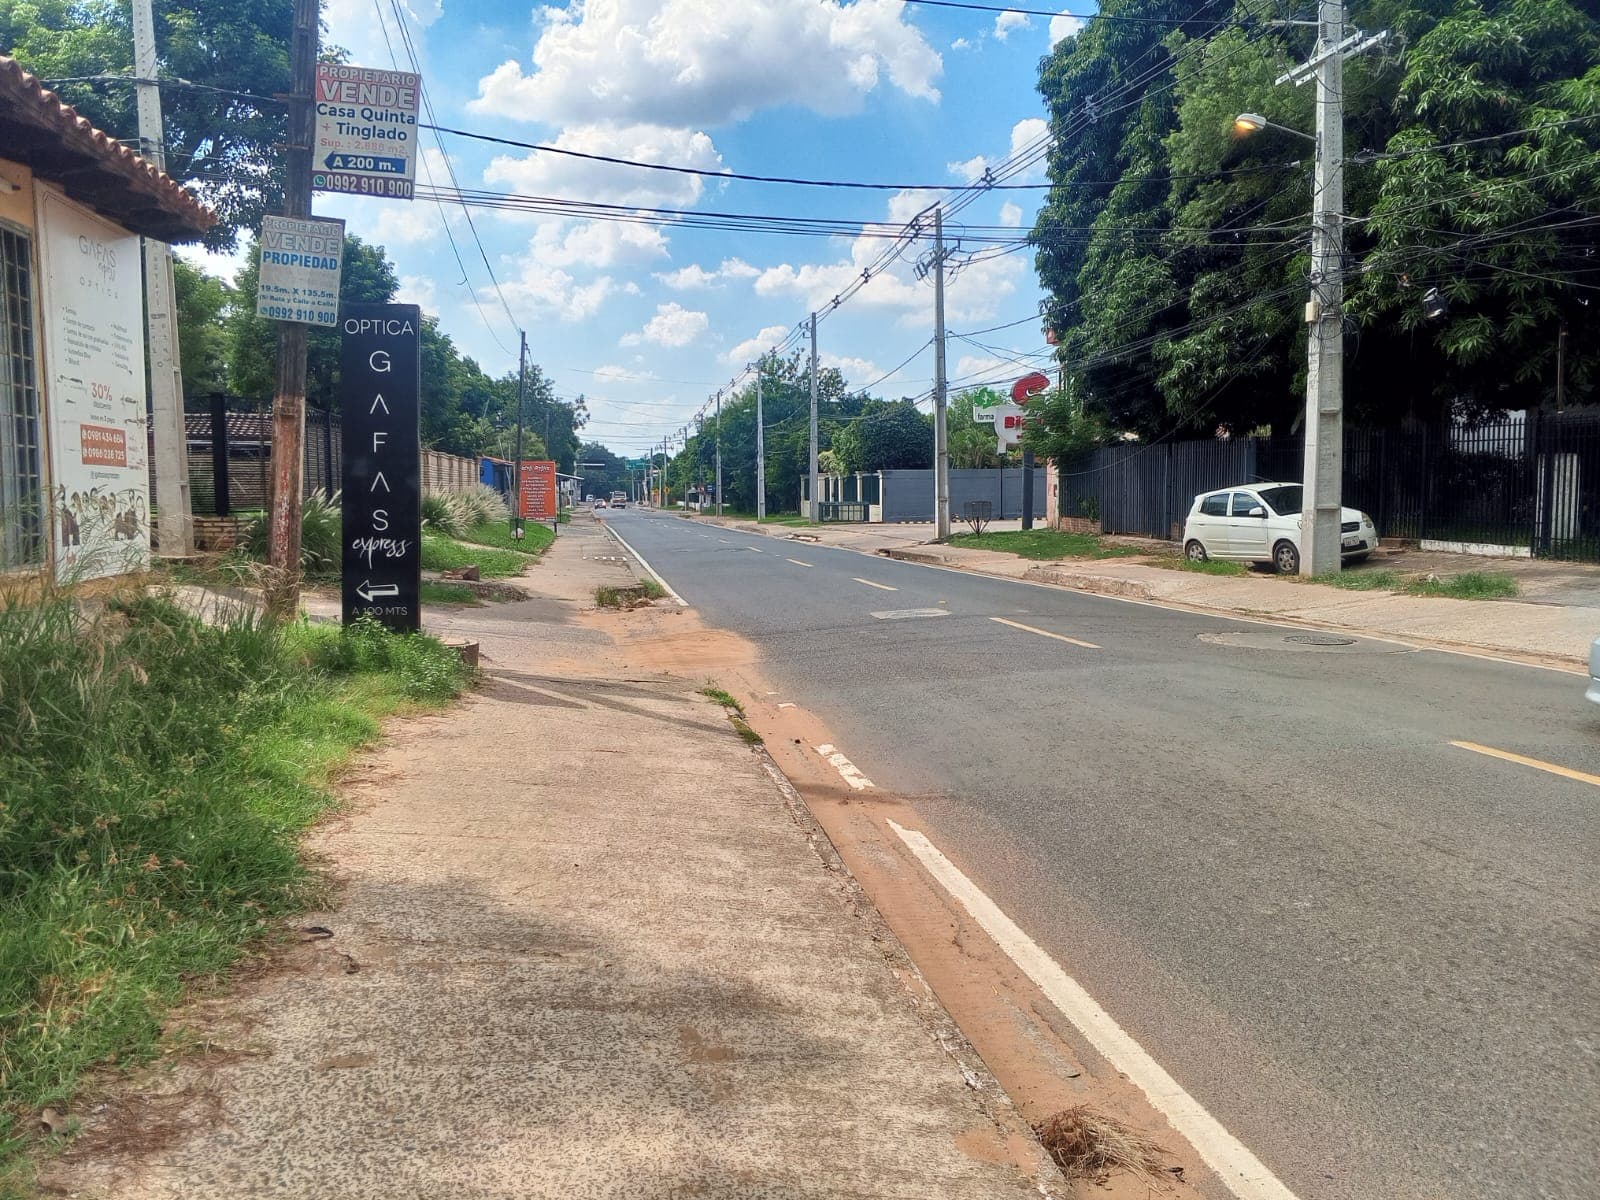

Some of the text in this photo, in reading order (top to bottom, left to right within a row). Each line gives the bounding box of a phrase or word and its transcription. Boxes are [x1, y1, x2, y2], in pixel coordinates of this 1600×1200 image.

[319, 66, 416, 86] PROPIETARIO
[320, 80, 415, 110] VENDE
[317, 103, 415, 125] Casa Quinta
[336, 122, 407, 141] Tinglado
[333, 156, 396, 171] A 200 m.
[326, 174, 411, 197] 0992 910 900
[265, 220, 339, 236] PROPIETARIO
[265, 231, 339, 255] VENDE
[263, 251, 338, 270] PROPIEDAD
[269, 307, 336, 324] 0992 910 900
[344, 319, 415, 336] OPTICA
[91, 382, 112, 401] 30%
[352, 536, 413, 570] express
[352, 607, 360, 616] A
[385, 606, 408, 616] MTS
